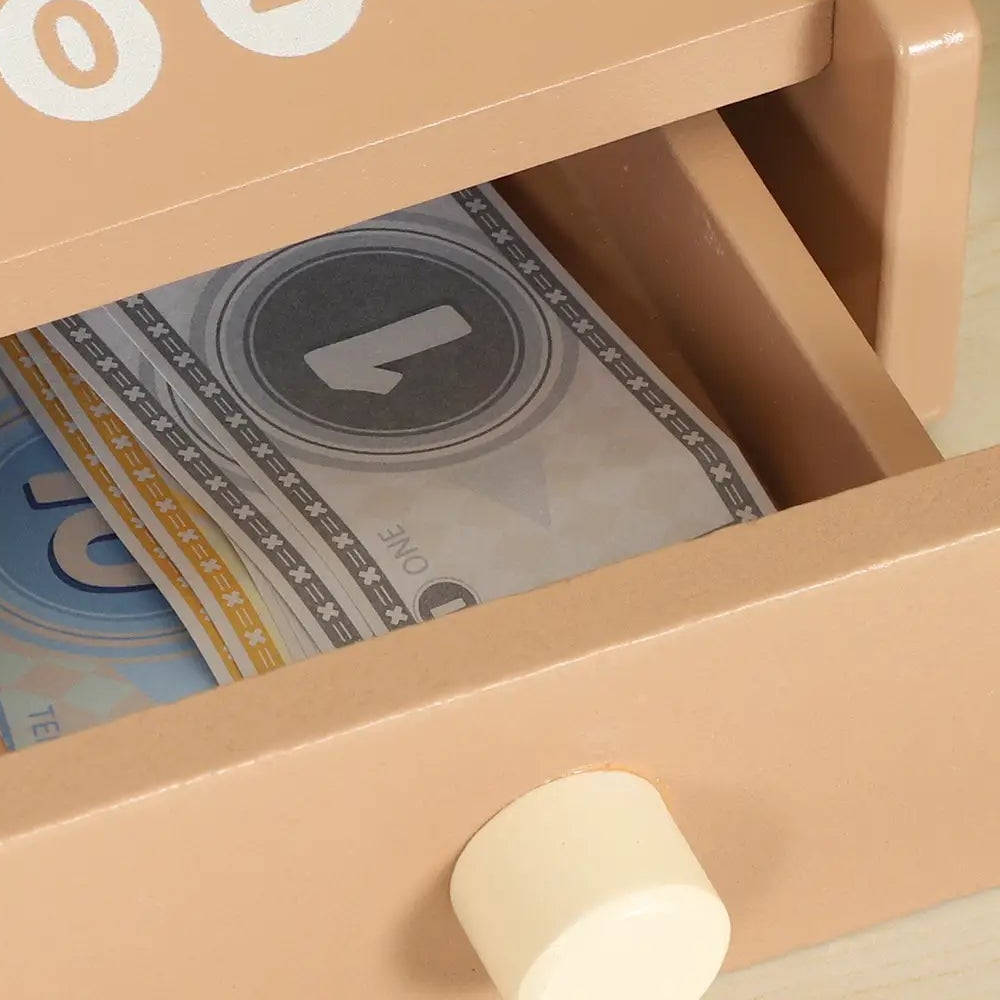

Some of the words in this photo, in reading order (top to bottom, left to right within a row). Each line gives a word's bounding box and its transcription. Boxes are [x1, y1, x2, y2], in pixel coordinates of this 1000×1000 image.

[303, 304, 472, 395] 1
[376, 523, 429, 576] ONE
[27, 704, 60, 742] TE
